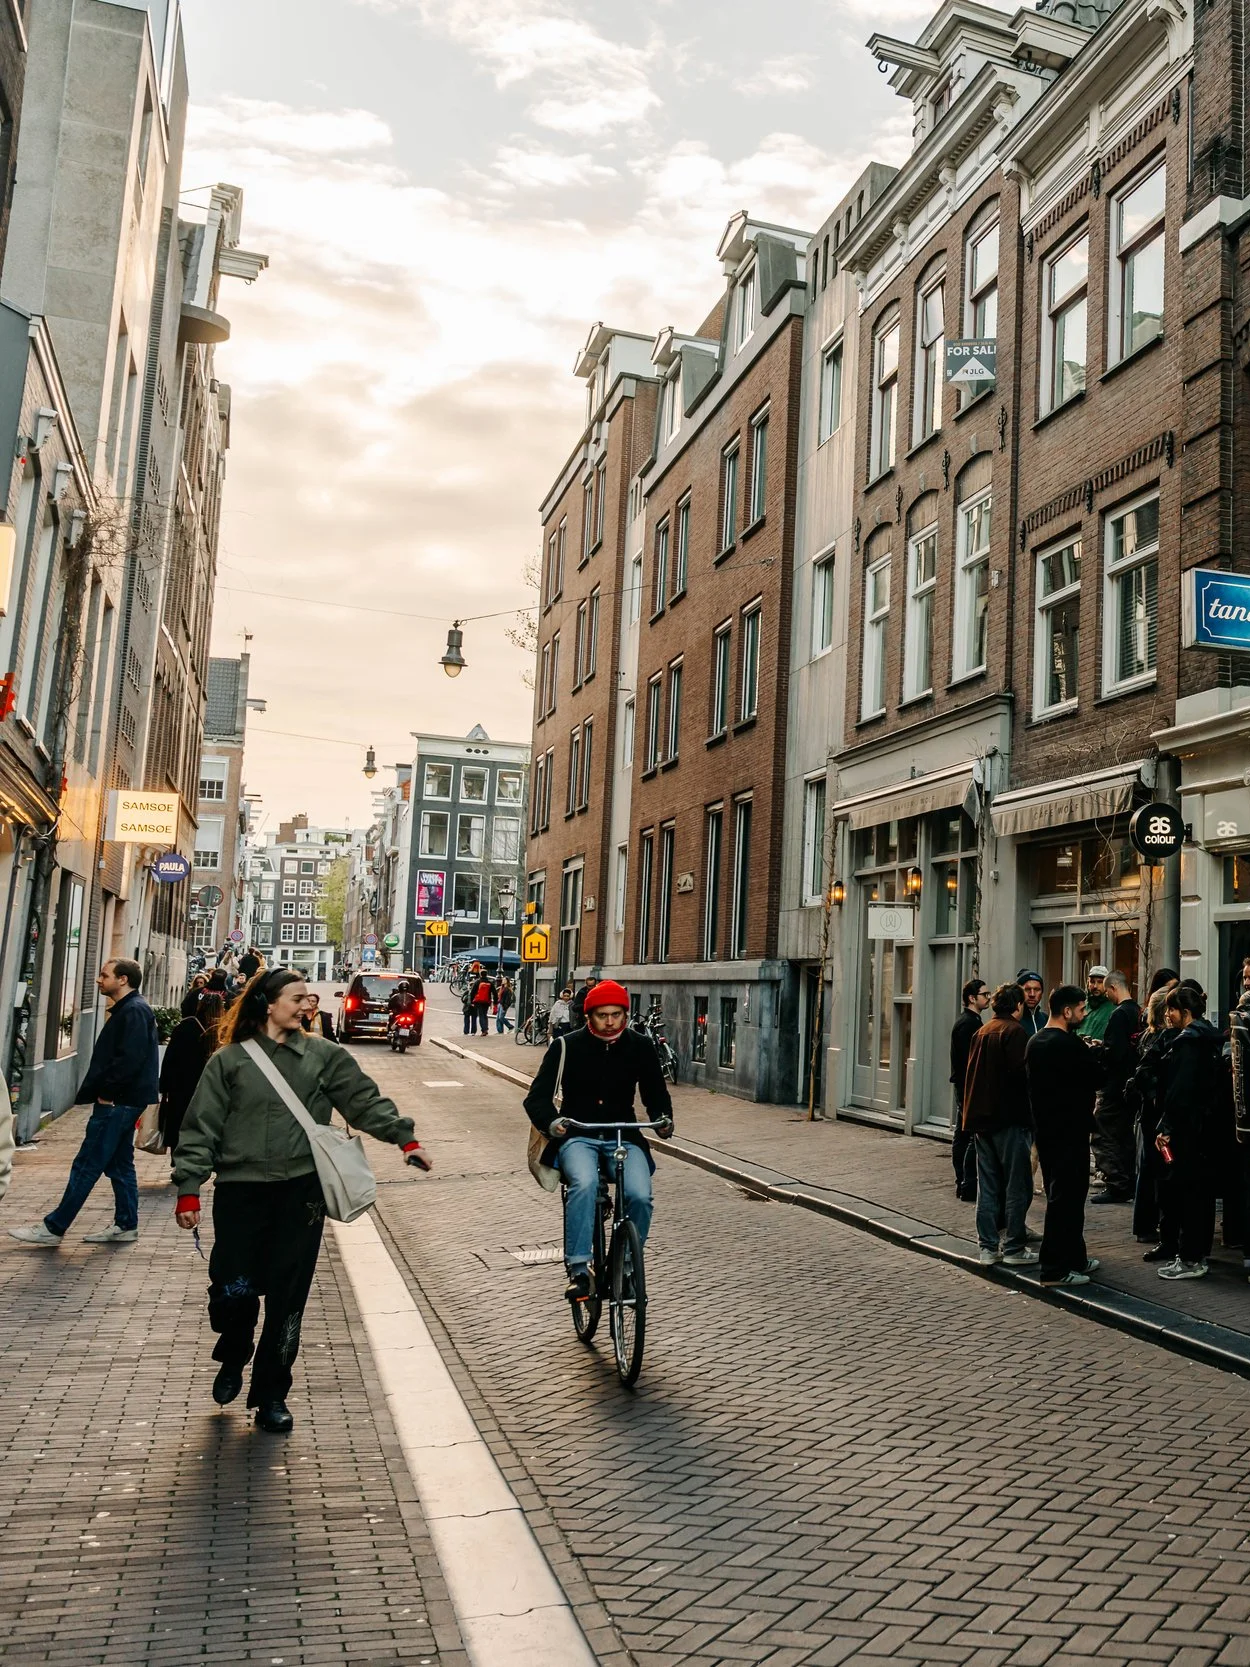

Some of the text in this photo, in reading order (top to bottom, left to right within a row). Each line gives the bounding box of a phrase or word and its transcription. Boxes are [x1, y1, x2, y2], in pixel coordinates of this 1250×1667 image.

[947, 346, 970, 356] FOR
[122, 801, 174, 812] SAMSØE
[120, 823, 173, 834] SAMSØE
[1149, 816, 1171, 834] as
[1144, 833, 1176, 845] colour
[159, 862, 185, 872] PAULA
[529, 941, 541, 954] H
